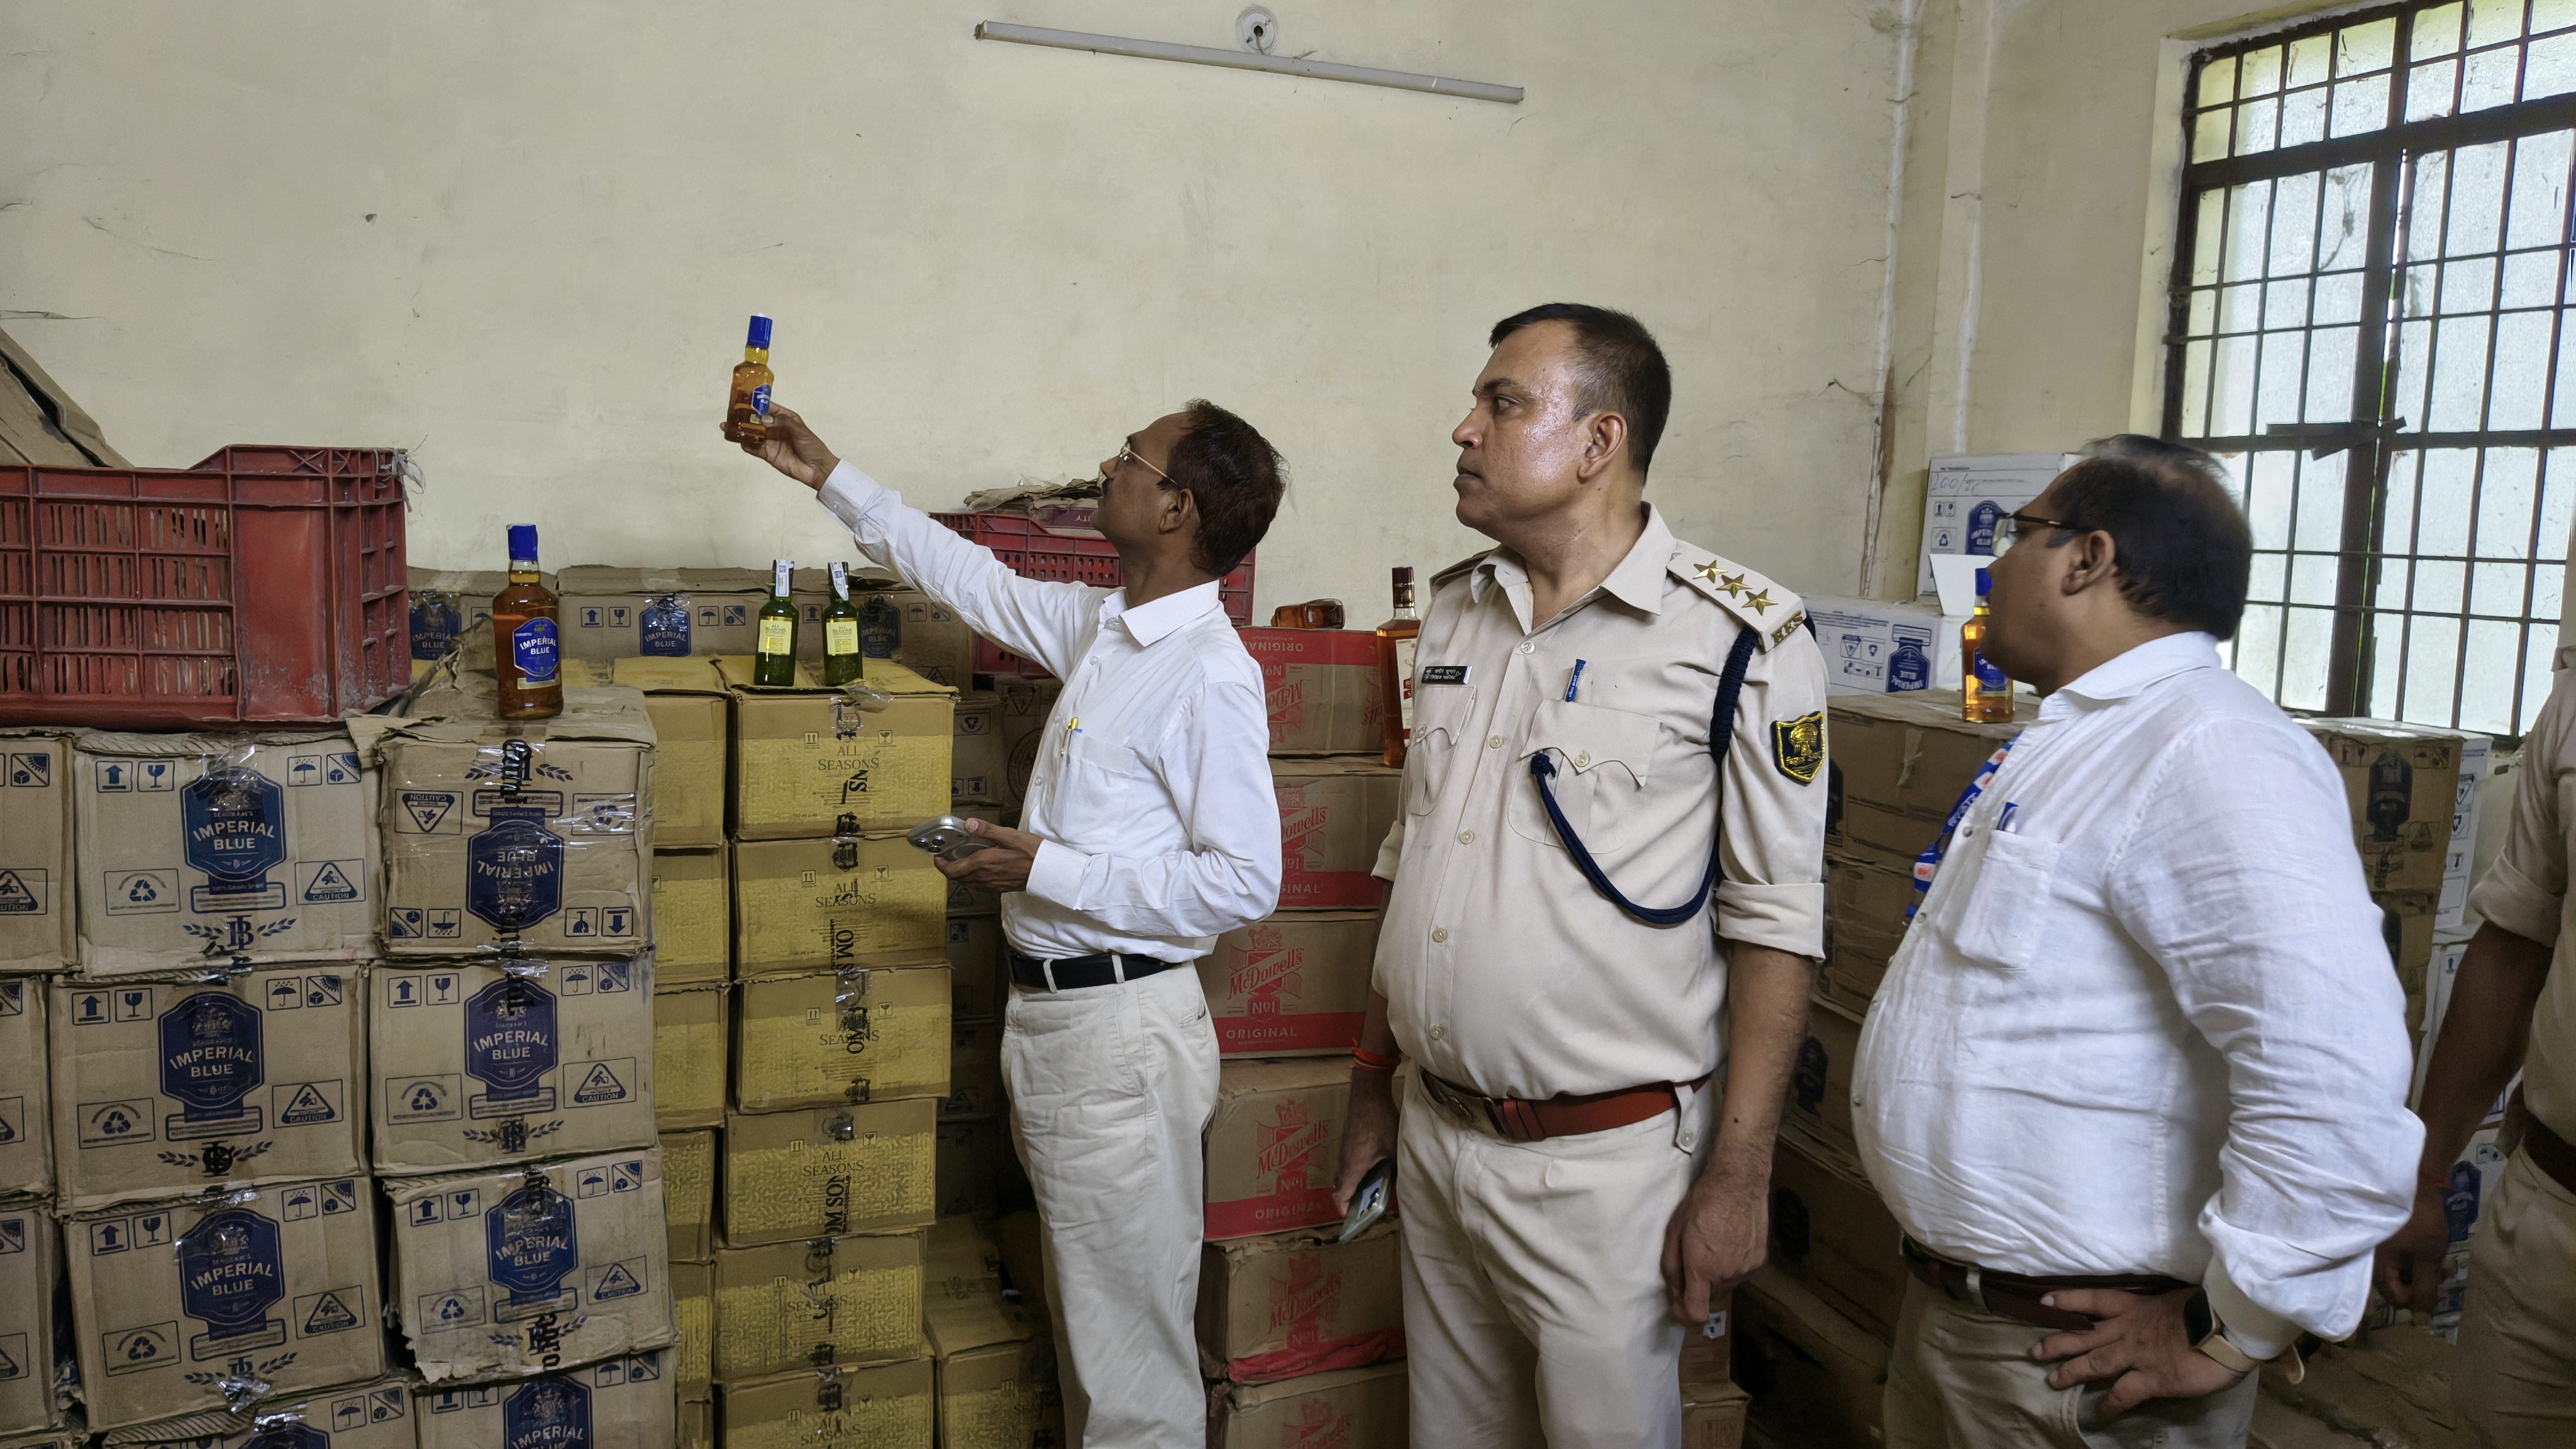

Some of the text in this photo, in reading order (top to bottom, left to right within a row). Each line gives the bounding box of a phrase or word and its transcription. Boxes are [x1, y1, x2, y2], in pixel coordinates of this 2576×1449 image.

[412, 632, 451, 641] IMPERIA
[519, 636, 557, 650] IMPERIAL
[645, 631, 687, 641] IMPERIAL
[530, 647, 550, 655] BLUE
[1246, 641, 1304, 652] ORIGINA
[1890, 674, 1923, 690] IMPERIAL
[1266, 679, 1304, 708] McDo
[837, 745, 862, 757] ALL
[818, 758, 879, 770] SEASONS
[411, 794, 447, 802] CAUTION
[193, 820, 275, 841] IMPERIAL
[214, 838, 255, 850] BLUE
[477, 859, 554, 879] IMPERIAL
[834, 880, 857, 894] ALL
[313, 892, 350, 901] CAUTION
[815, 892, 876, 908] SEASONS
[0, 903, 28, 911] UTION
[1228, 947, 1304, 1000] McDowell's
[1226, 1026, 1297, 1040] ORIGINAL
[474, 1030, 548, 1052] IMPERIAL
[169, 1046, 253, 1069] IMPERIAL
[492, 1046, 531, 1060] BLUE
[191, 1063, 233, 1077] BLUE
[582, 1092, 619, 1102] CAUTION
[289, 1113, 327, 1123] CAUTION
[823, 1150, 846, 1163] ALL
[803, 1159, 865, 1177] SEASONS
[495, 1235, 569, 1260] IMPERIAL
[514, 1251, 552, 1267] BLUE
[191, 1262, 273, 1291] IMPERIAL
[213, 1279, 255, 1296] BLUE
[512, 1423, 584, 1449] IMPERIAL
